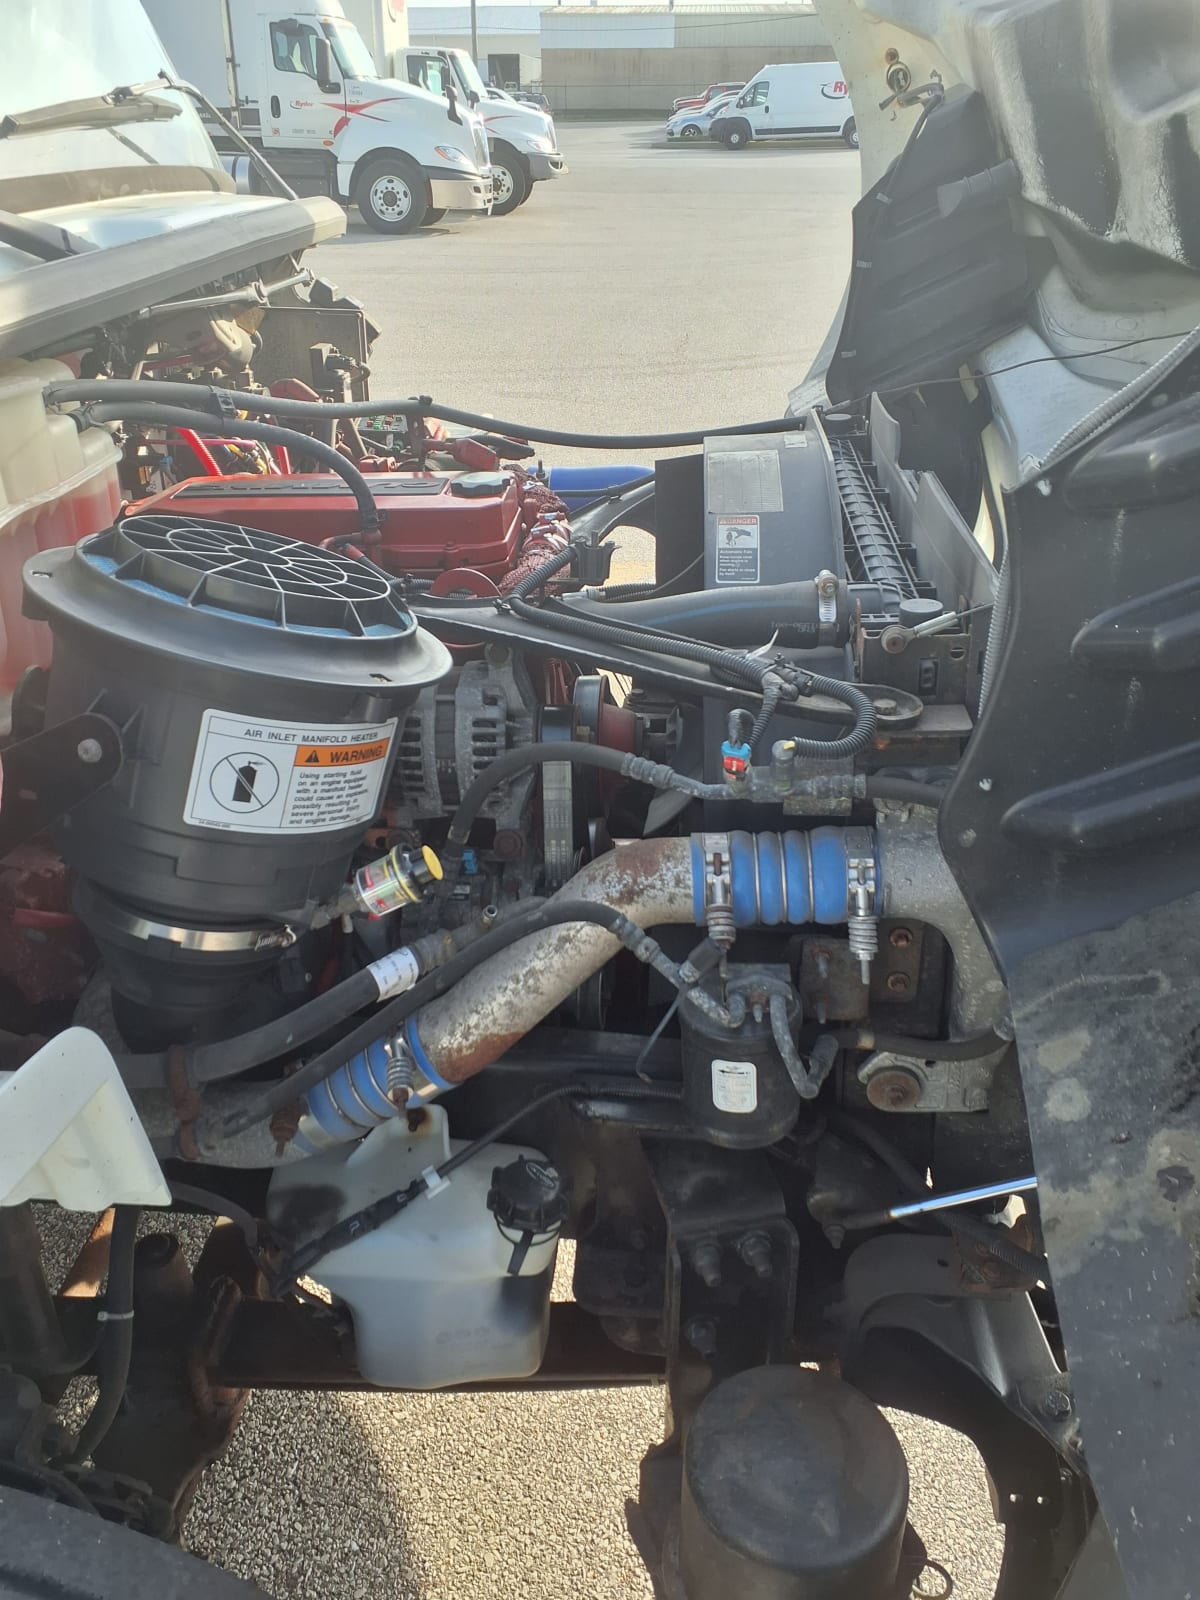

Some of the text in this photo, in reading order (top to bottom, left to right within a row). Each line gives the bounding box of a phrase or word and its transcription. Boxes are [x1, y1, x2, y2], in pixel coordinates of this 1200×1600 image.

[244, 729, 378, 744] AIR INLET MANIFOLD HEATER
[329, 745, 383, 763] WARNING
[299, 771, 320, 780] Using
[323, 771, 348, 780] starting
[320, 786, 346, 794] manifold
[291, 802, 321, 810] possibly
[325, 799, 350, 808] resulting
[317, 807, 344, 817] personal
[305, 817, 327, 825] engine
